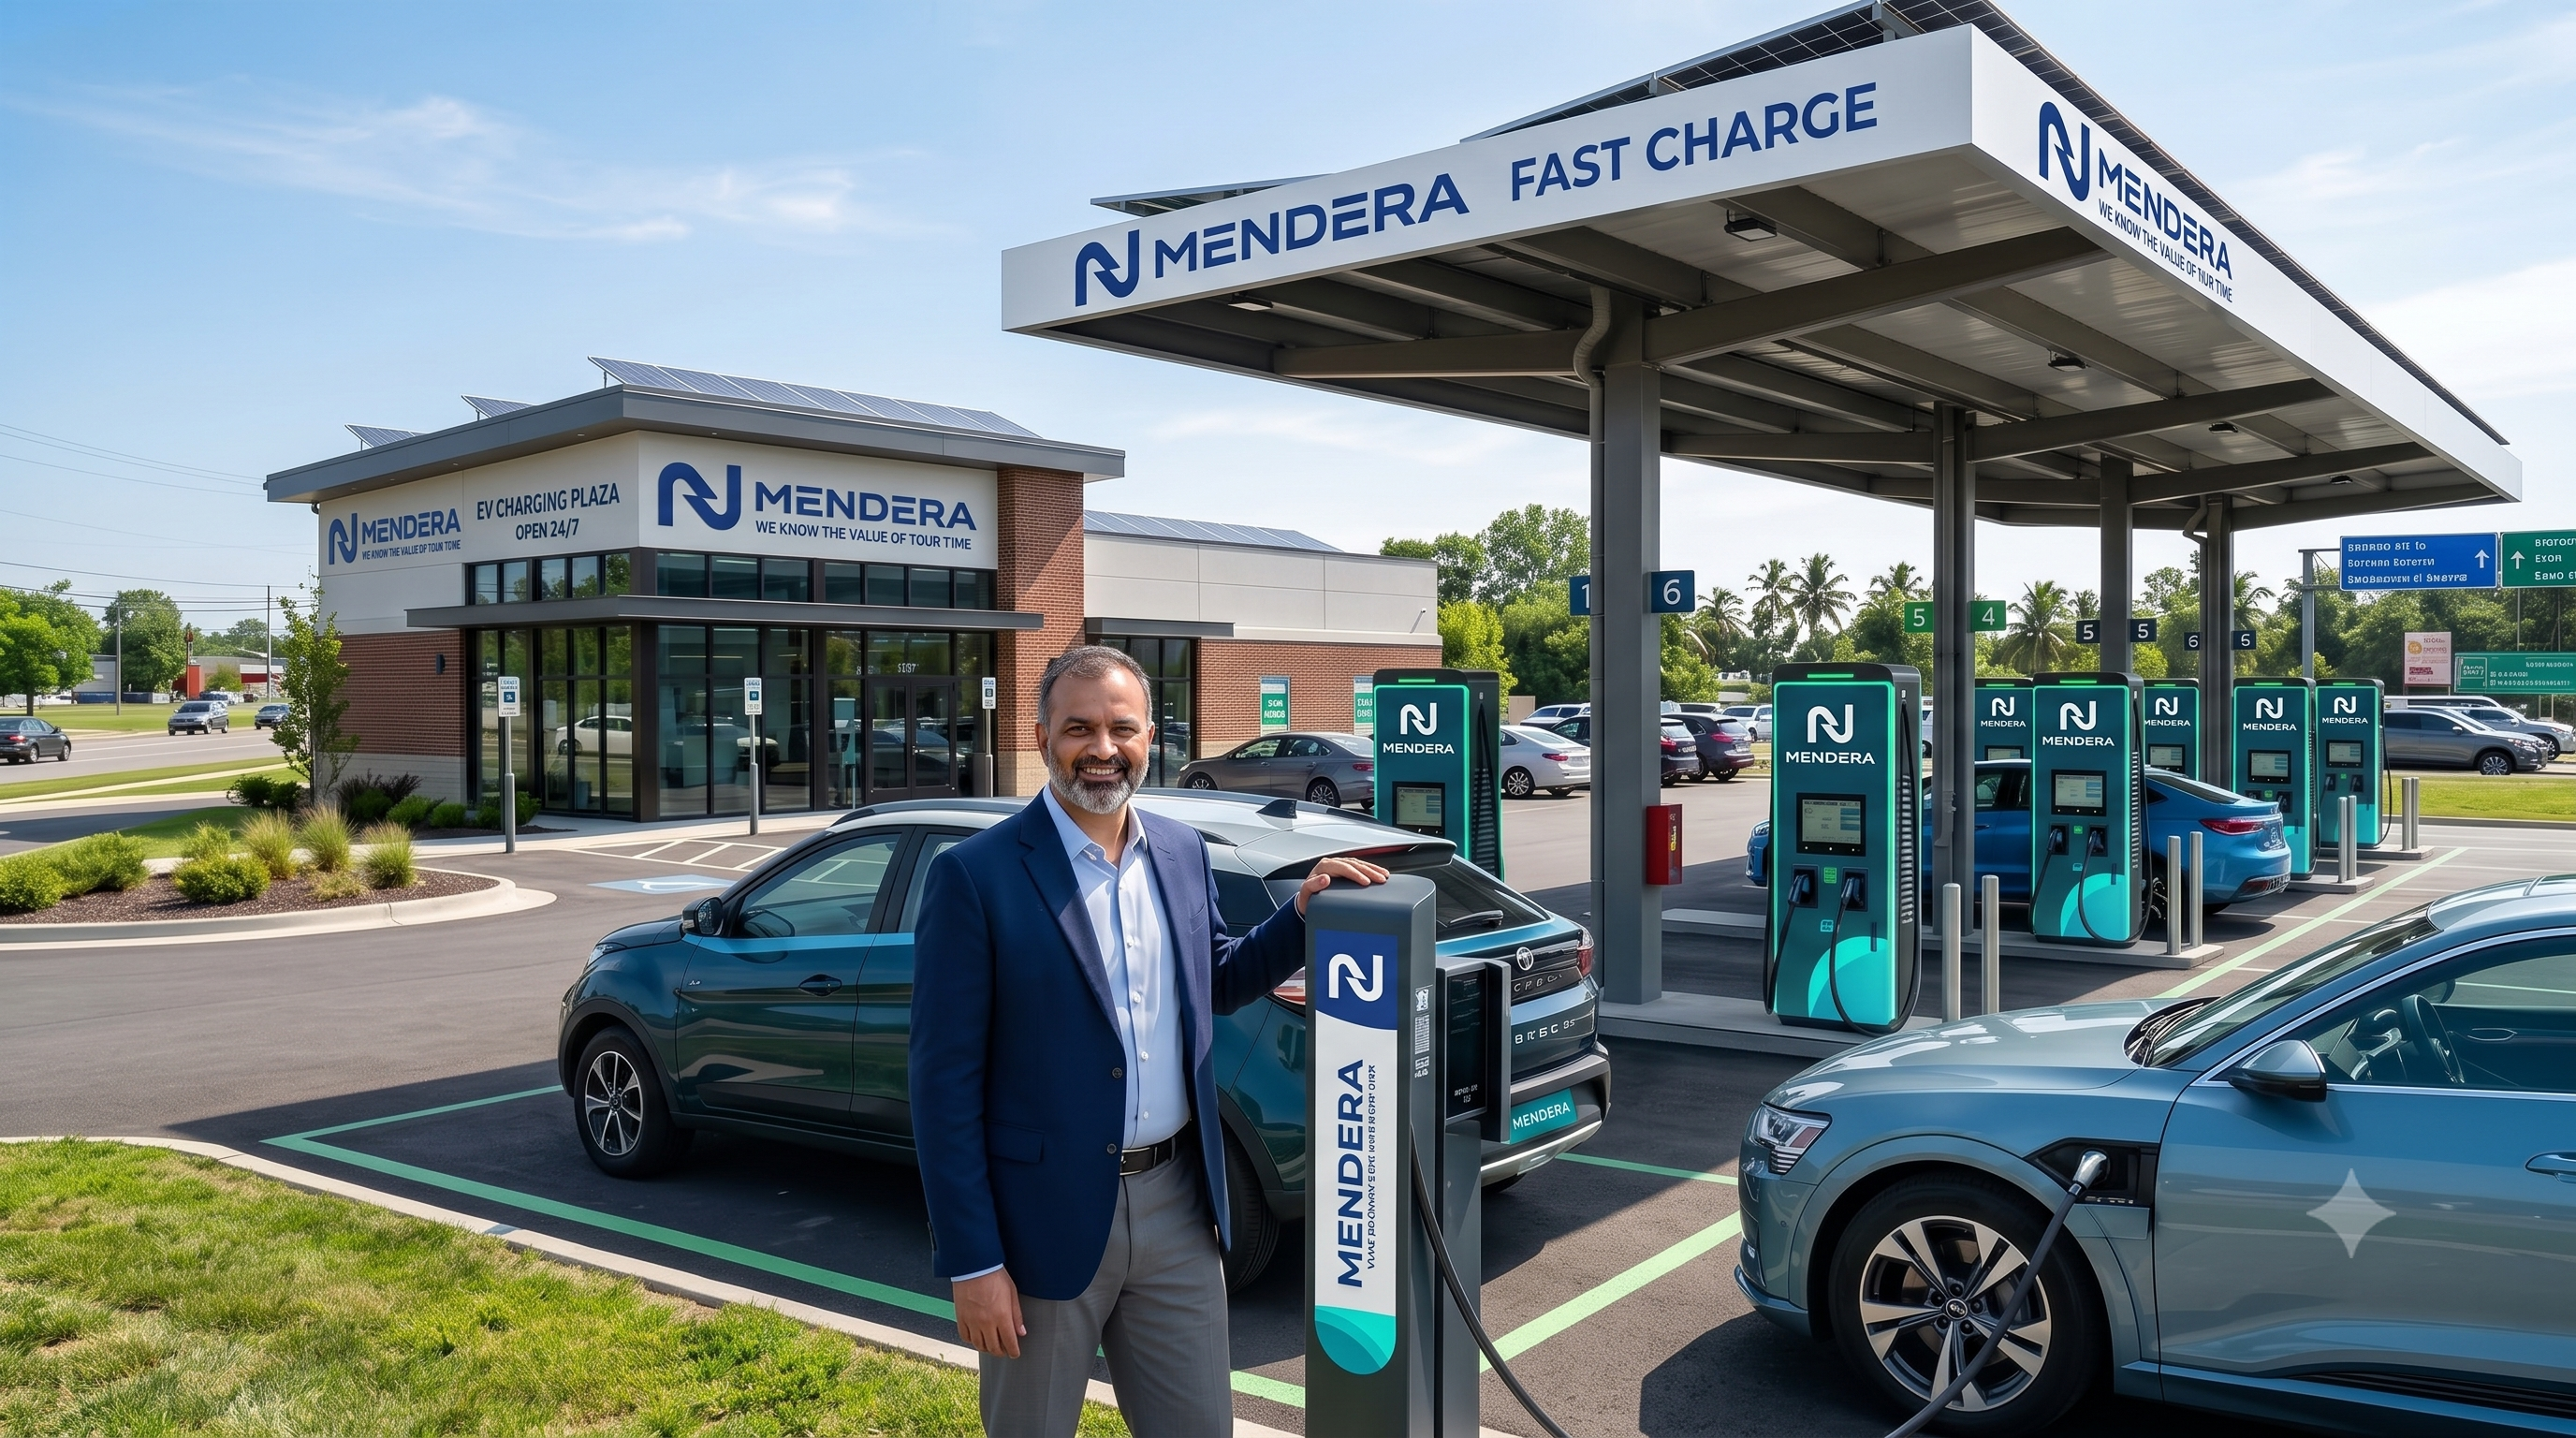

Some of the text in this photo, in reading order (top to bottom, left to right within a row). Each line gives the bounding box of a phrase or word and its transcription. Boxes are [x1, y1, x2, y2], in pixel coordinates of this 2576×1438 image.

[1155, 82, 1878, 279] MENDERA FAST CHARGE
[2100, 147, 2232, 280] MENDERA
[2099, 198, 2113, 222] WE
[2115, 210, 2141, 241] KNOW
[2143, 228, 2158, 253] THE
[2159, 241, 2185, 271] VALUE
[2187, 260, 2197, 277] OF
[477, 482, 620, 520] EV CHARGING PLAZA
[755, 481, 977, 531] MENDERA
[362, 508, 461, 544] MENDERA
[516, 518, 579, 540] OPEN 24/7
[755, 520, 972, 550] WE KNOW THE VALUE OF TOUR TIME
[389, 547, 400, 557] THE
[400, 544, 418, 555] VALUE
[1663, 579, 1681, 605] 6
[1912, 608, 1925, 627] 5
[1982, 607, 1995, 625] 4
[2083, 624, 2094, 640] 5
[2137, 624, 2149, 638] 5
[2241, 634, 2251, 647] 5
[2188, 635, 2199, 648] 6
[2243, 723, 2297, 731] MENDERA
[1383, 741, 1455, 755] MENDERA
[2042, 736, 2115, 747] MENDERA
[1785, 751, 1876, 766] MENDERA
[1513, 1101, 1571, 1130] MENDERA
[1338, 1059, 1364, 1288] MENDERA
